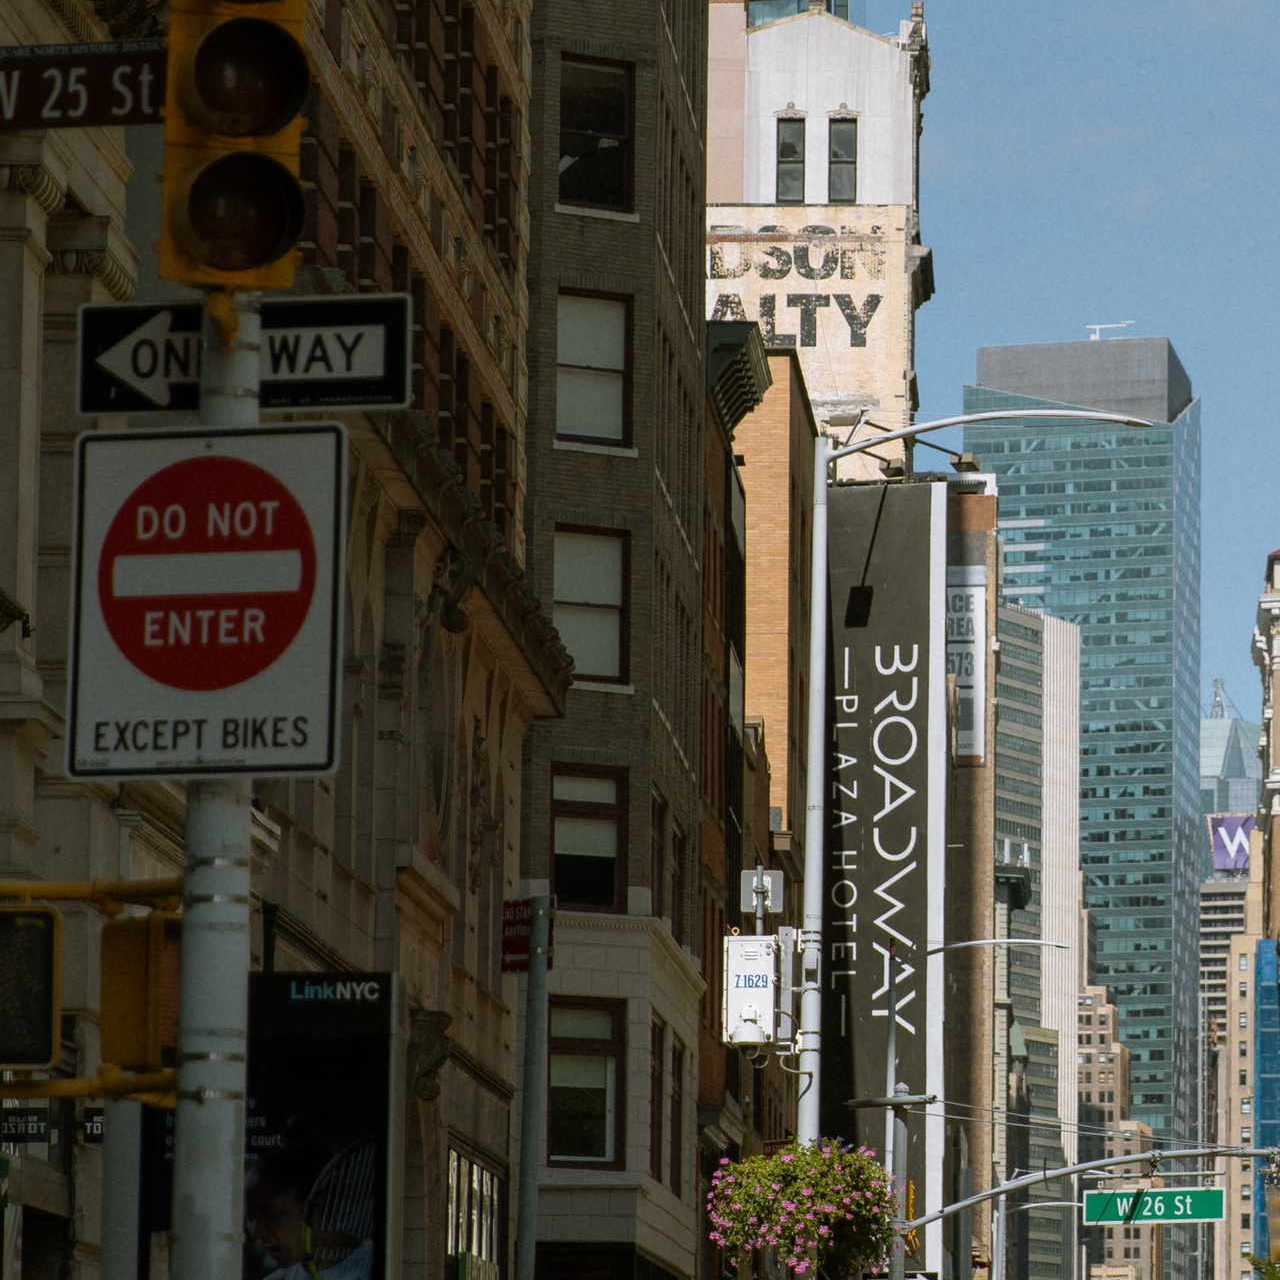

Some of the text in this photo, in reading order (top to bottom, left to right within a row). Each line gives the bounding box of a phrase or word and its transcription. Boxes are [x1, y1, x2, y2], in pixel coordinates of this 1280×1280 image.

[34, 46, 69, 56] NORTH
[72, 44, 120, 54] HISTORIC
[41, 66, 88, 118] 25
[111, 63, 154, 115] St
[131, 332, 364, 378] ON WAY
[136, 500, 280, 540] DO NOT
[143, 608, 266, 647] ENTER
[94, 716, 309, 752] EXCEPT BIKES
[831, 695, 858, 989] PLAZA HOTEL
[872, 644, 919, 1034] BROADWAY
[290, 981, 380, 1000] LinkNYC
[1117, 1194, 1193, 1217] W 26 St
